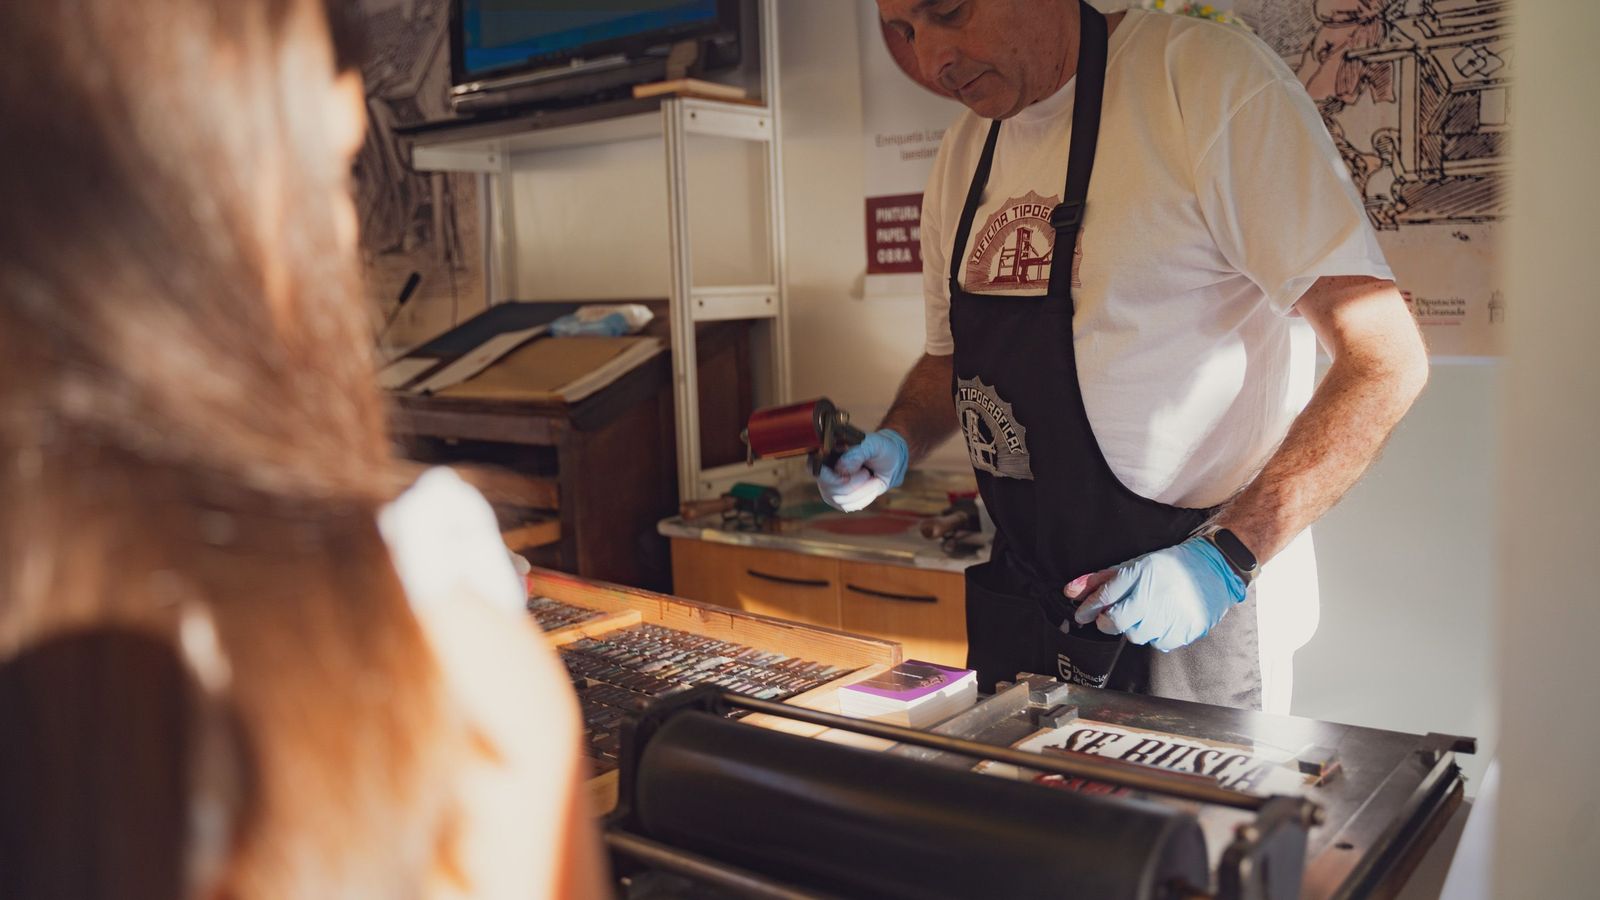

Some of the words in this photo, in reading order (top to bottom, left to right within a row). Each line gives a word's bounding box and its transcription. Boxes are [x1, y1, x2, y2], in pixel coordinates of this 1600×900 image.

[875, 206, 920, 222] PINTURA
[876, 227, 909, 243] PAPEL
[973, 212, 1009, 260] OFICINA
[877, 248, 912, 264] OBRA
[1050, 728, 1126, 756] SE
[1118, 738, 1274, 791] BUSCA
